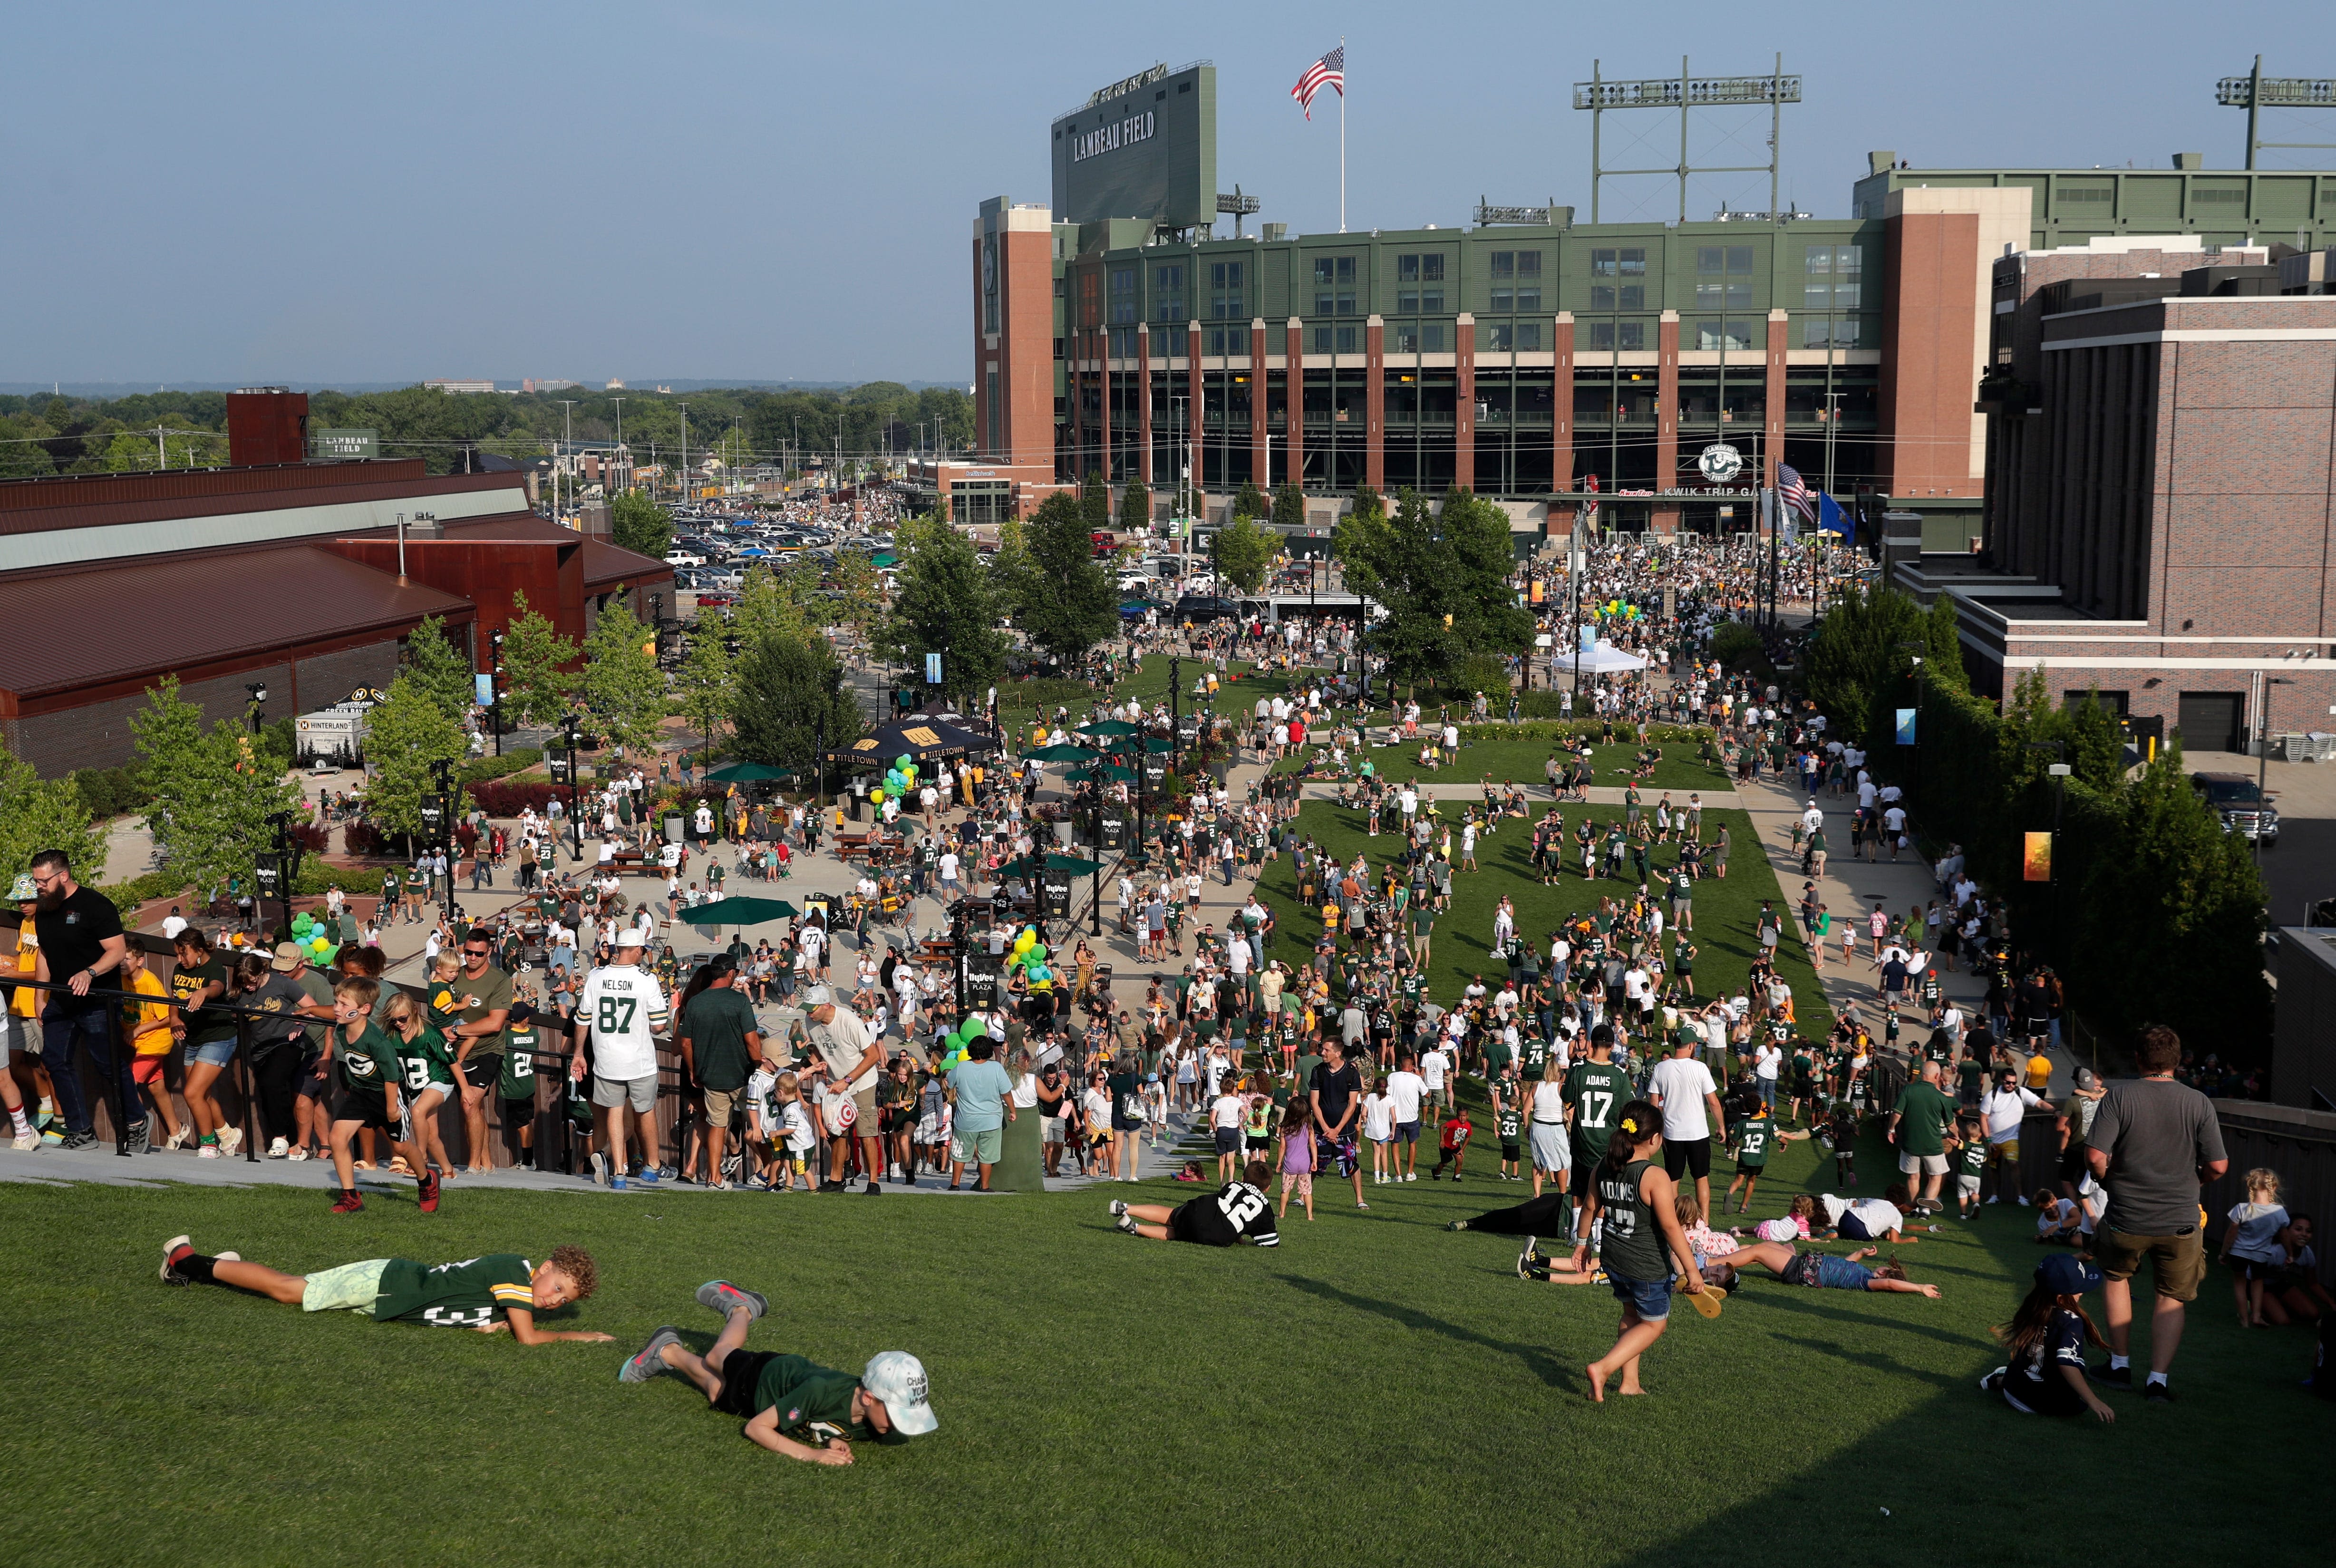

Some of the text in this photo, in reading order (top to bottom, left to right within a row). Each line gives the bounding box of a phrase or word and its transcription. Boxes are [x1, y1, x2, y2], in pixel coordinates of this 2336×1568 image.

[1075, 111, 1154, 162] LAMBEAU FIELD
[1665, 487, 1774, 497] KWIK TRIP GAE
[928, 746, 964, 758] TITLETOWN
[837, 754, 877, 765] TITLETOWN
[701, 816, 706, 824] 4
[1811, 816, 1819, 826] 41
[1210, 828, 1214, 837] 2
[1256, 838, 1263, 848] 87
[541, 850, 551, 859] 23
[666, 852, 674, 860] 12
[926, 852, 934, 861] 17
[710, 869, 715, 879] 1
[1140, 922, 1147, 930] 33
[1872, 920, 1883, 929] 12
[807, 934, 819, 944] 77
[602, 980, 633, 991] NELSON
[1927, 988, 1937, 998] 12
[1736, 1005, 1747, 1013] 25
[599, 997, 637, 1034] 87
[1284, 1030, 1294, 1039] 12
[1773, 1027, 1787, 1041] 33
[513, 1036, 534, 1045] WOODSON
[1262, 1036, 1270, 1046] 21
[1529, 1050, 1543, 1064] 74
[1586, 1075, 1610, 1086] ADAMS
[1506, 1083, 1512, 1095] 7
[1854, 1085, 1863, 1094] 12
[1580, 1091, 1613, 1128] 17
[1502, 1121, 1517, 1136] 33
[1741, 1133, 1764, 1153] 12
[1600, 1180, 1634, 1202] ADAMS
[1218, 1182, 1264, 1233] 12
[1604, 1206, 1636, 1238] 17
